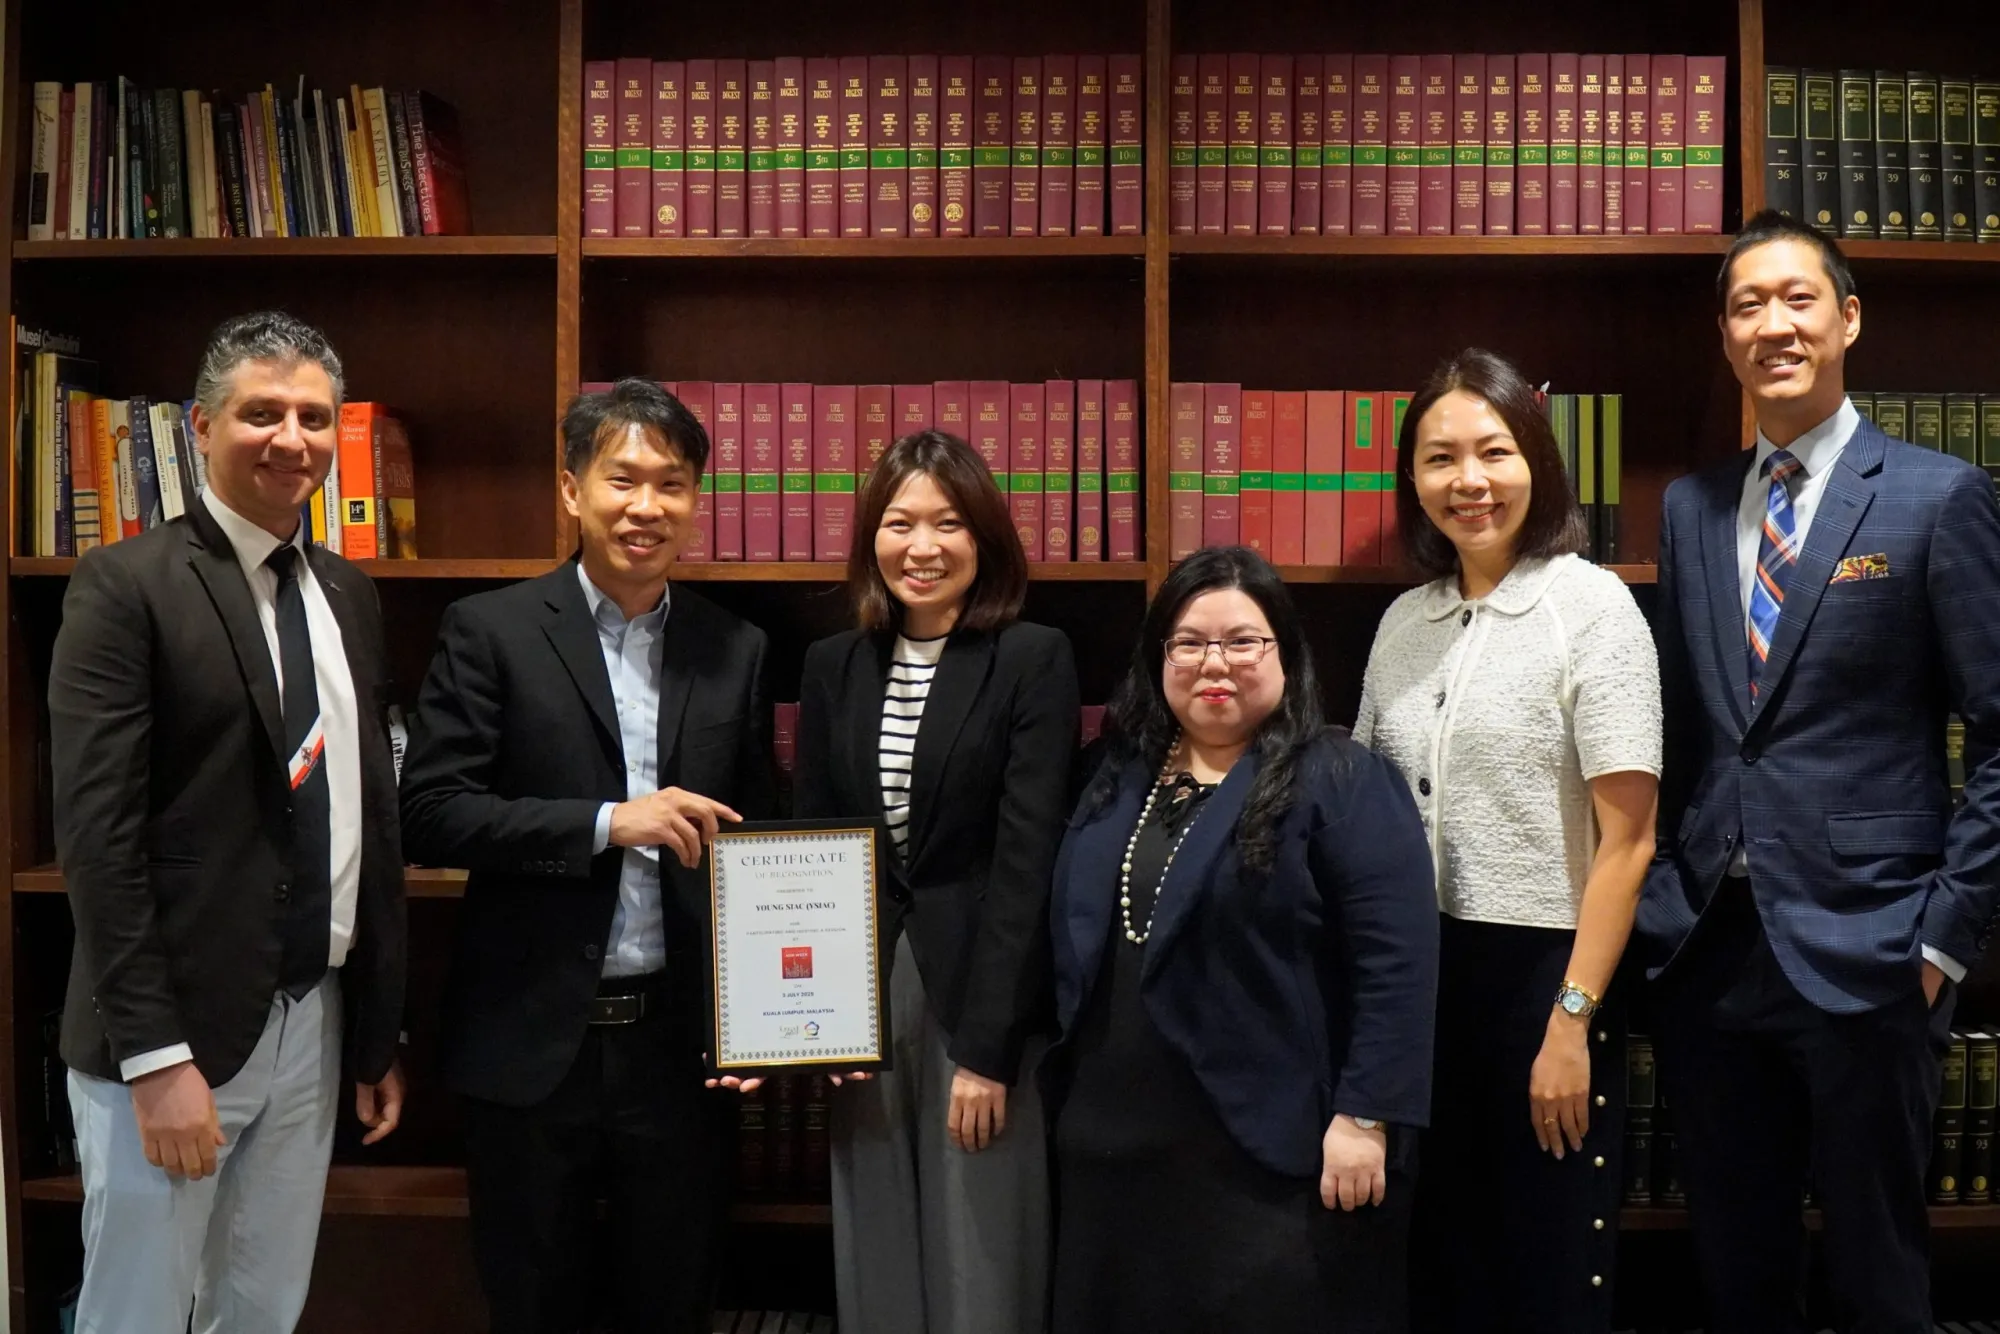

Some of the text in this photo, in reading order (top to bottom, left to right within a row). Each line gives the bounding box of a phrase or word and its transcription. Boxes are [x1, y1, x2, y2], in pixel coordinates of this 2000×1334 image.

[850, 79, 859, 87] THE
[918, 78, 928, 86] THE
[952, 78, 961, 86] THE
[1401, 77, 1410, 85] THE
[1464, 76, 1474, 84] THE
[1496, 77, 1505, 85] THE
[1527, 75, 1537, 83] THE
[1587, 75, 1597, 83] THE
[1632, 76, 1643, 84] THE
[1700, 76, 1710, 84] THE
[696, 82, 705, 90] THE
[818, 80, 828, 88] THE
[1556, 84, 1573, 92] DIGEST
[781, 88, 798, 96] DIGEST
[846, 89, 862, 97] DIGEST
[881, 88, 898, 96] DIGEST
[914, 88, 932, 96] DIGEST
[948, 88, 965, 96] DIGEST
[1523, 85, 1541, 93] DIGEST
[1583, 85, 1601, 93] DIGEST
[1628, 86, 1646, 94] DIGEST
[591, 90, 608, 98] DIGEST
[660, 91, 676, 99] DIGEST
[692, 92, 709, 100] DIGEST
[814, 90, 831, 98] DIGEST
[373, 130, 390, 188] SESSION
[887, 154, 892, 163] 6
[1365, 151, 1375, 159] 45
[1662, 153, 1672, 162] 50
[1697, 151, 1710, 160] 50
[666, 156, 671, 165] 2
[411, 121, 432, 222] Time Detectives
[1778, 170, 1790, 180] 36
[1816, 171, 1828, 181] 37
[1853, 172, 1864, 182] 38
[1887, 173, 1898, 183] 39
[1919, 173, 1931, 183] 40
[1952, 175, 1964, 185] 41
[1985, 177, 1996, 187] 42
[17, 324, 42, 347] Musei
[723, 404, 733, 412] THE
[793, 404, 803, 412] THE
[1085, 402, 1096, 410] THE
[1218, 406, 1228, 414] THE
[719, 413, 737, 421] DIGEST
[789, 414, 807, 422] DIGEST
[1082, 412, 1099, 420] DIGEST
[1022, 478, 1034, 487] 16
[1120, 478, 1130, 487] 18
[741, 852, 847, 866] CERTIFICATE
[755, 869, 833, 879] OF RECOGNITION
[806, 902, 835, 911] (YSIAC)
[1944, 1139, 1956, 1149] 92
